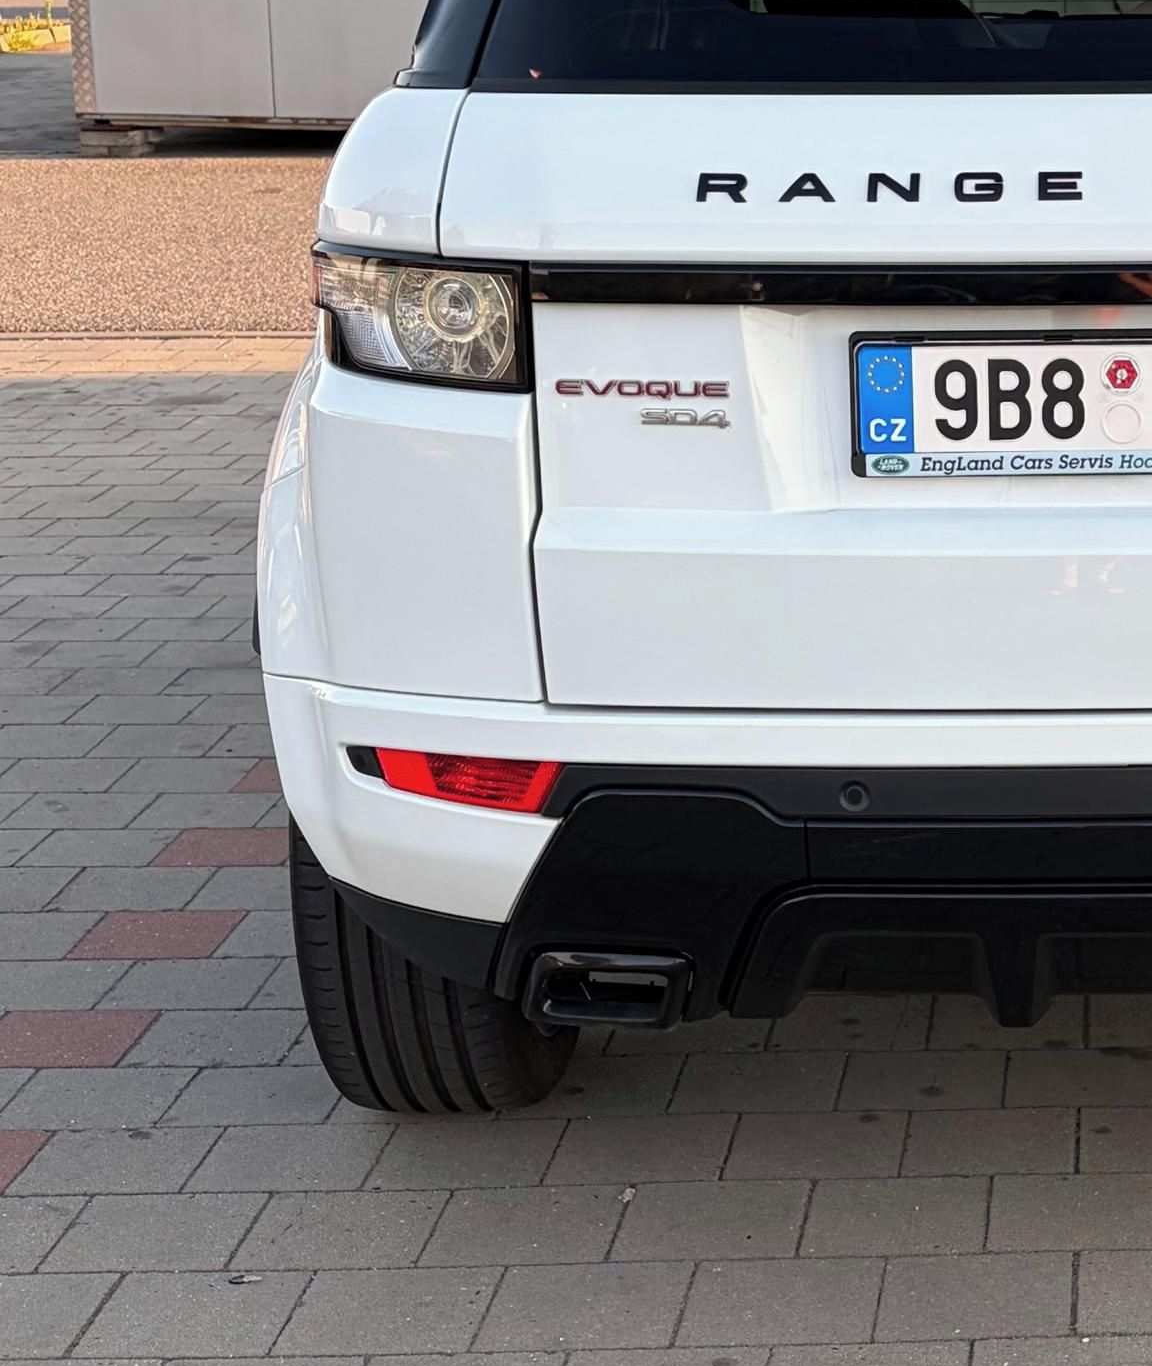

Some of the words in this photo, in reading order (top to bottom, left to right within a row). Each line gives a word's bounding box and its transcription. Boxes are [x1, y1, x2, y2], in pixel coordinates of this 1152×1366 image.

[695, 170, 1084, 204] RANGE
[555, 378, 731, 401] EVOQUE
[932, 357, 1086, 442] 9B8
[640, 407, 732, 429] SD4
[869, 418, 907, 443] CZ
[919, 455, 1004, 475] EngLand
[1010, 454, 1054, 471] Cars
[1058, 453, 1113, 470] Servis
